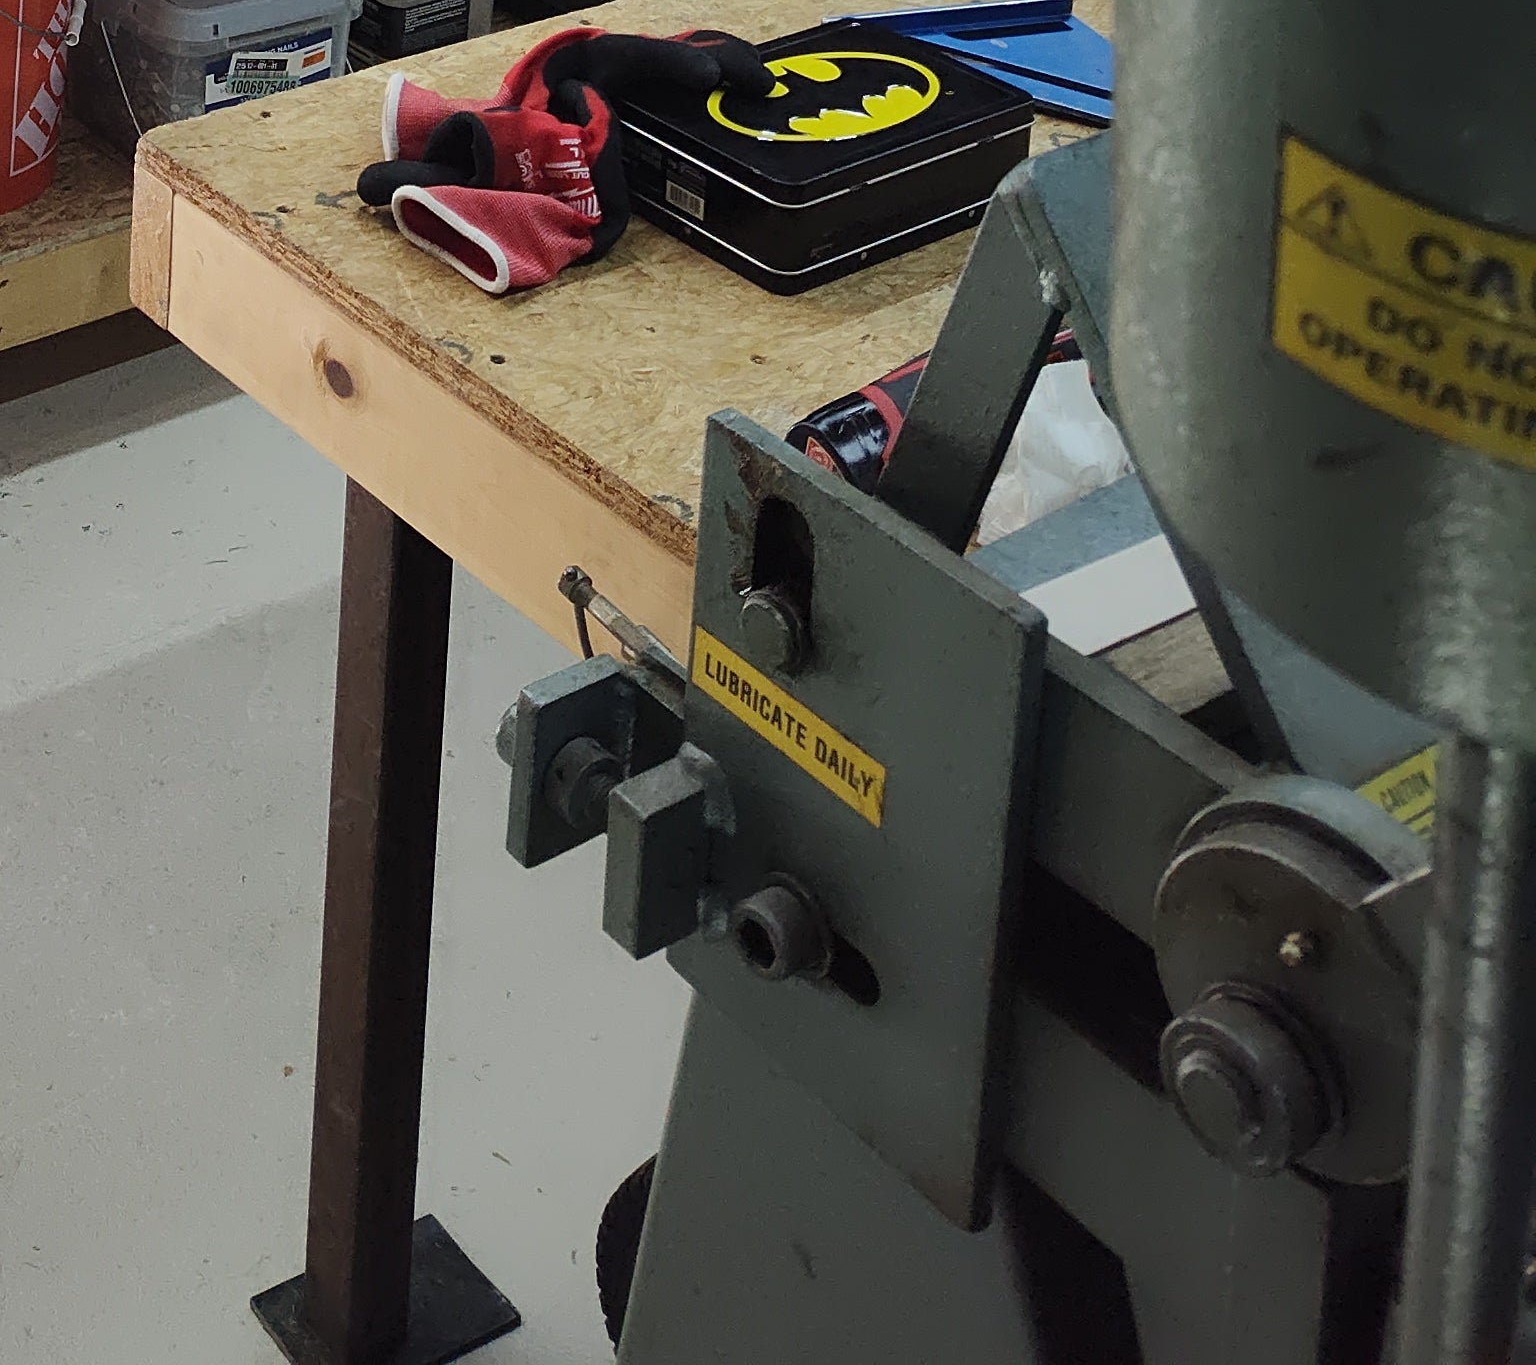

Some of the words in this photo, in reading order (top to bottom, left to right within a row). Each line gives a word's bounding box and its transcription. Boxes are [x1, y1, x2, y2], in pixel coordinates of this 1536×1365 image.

[1404, 231, 1536, 317] CA
[1367, 296, 1443, 354] DO
[705, 653, 808, 751] LUBRICATE
[814, 735, 876, 798] DAILY
